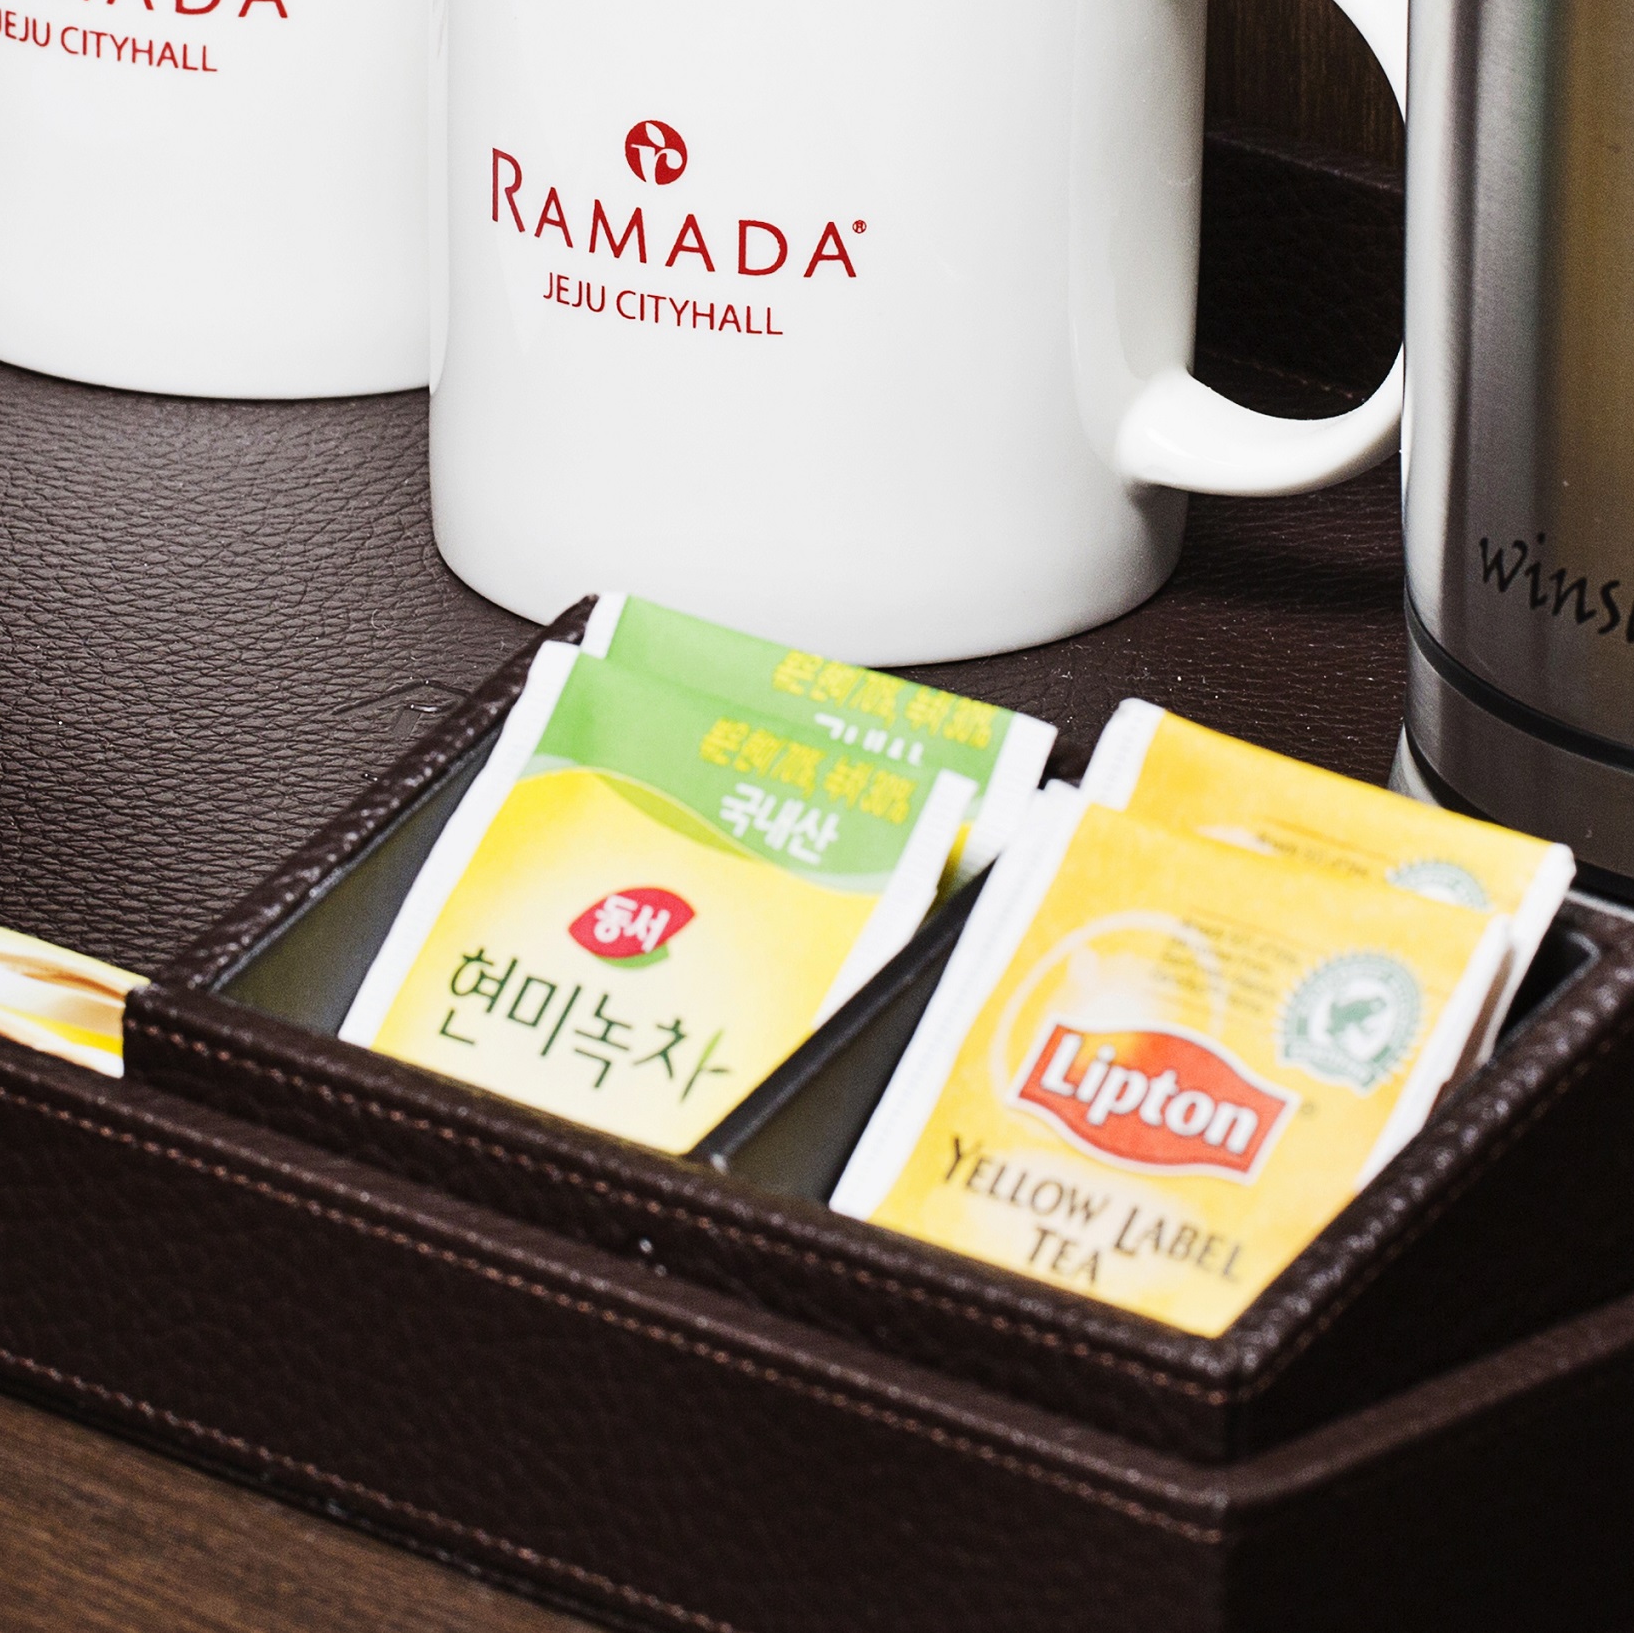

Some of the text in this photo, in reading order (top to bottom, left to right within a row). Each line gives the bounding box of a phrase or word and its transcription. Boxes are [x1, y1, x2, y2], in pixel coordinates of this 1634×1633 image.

[60, 26, 218, 72] CITYHALL
[491, 147, 857, 278] RAMADA
[543, 272, 783, 335] JEJU CITYHALL
[720, 782, 840, 865] 국내산
[593, 893, 671, 954] 동서
[439, 948, 730, 1102] 현미녹차
[1040, 1033, 1258, 1155] Lipton
[944, 1133, 1244, 1284] YELLOW LABEL
[1028, 1226, 1102, 1285] TEA
